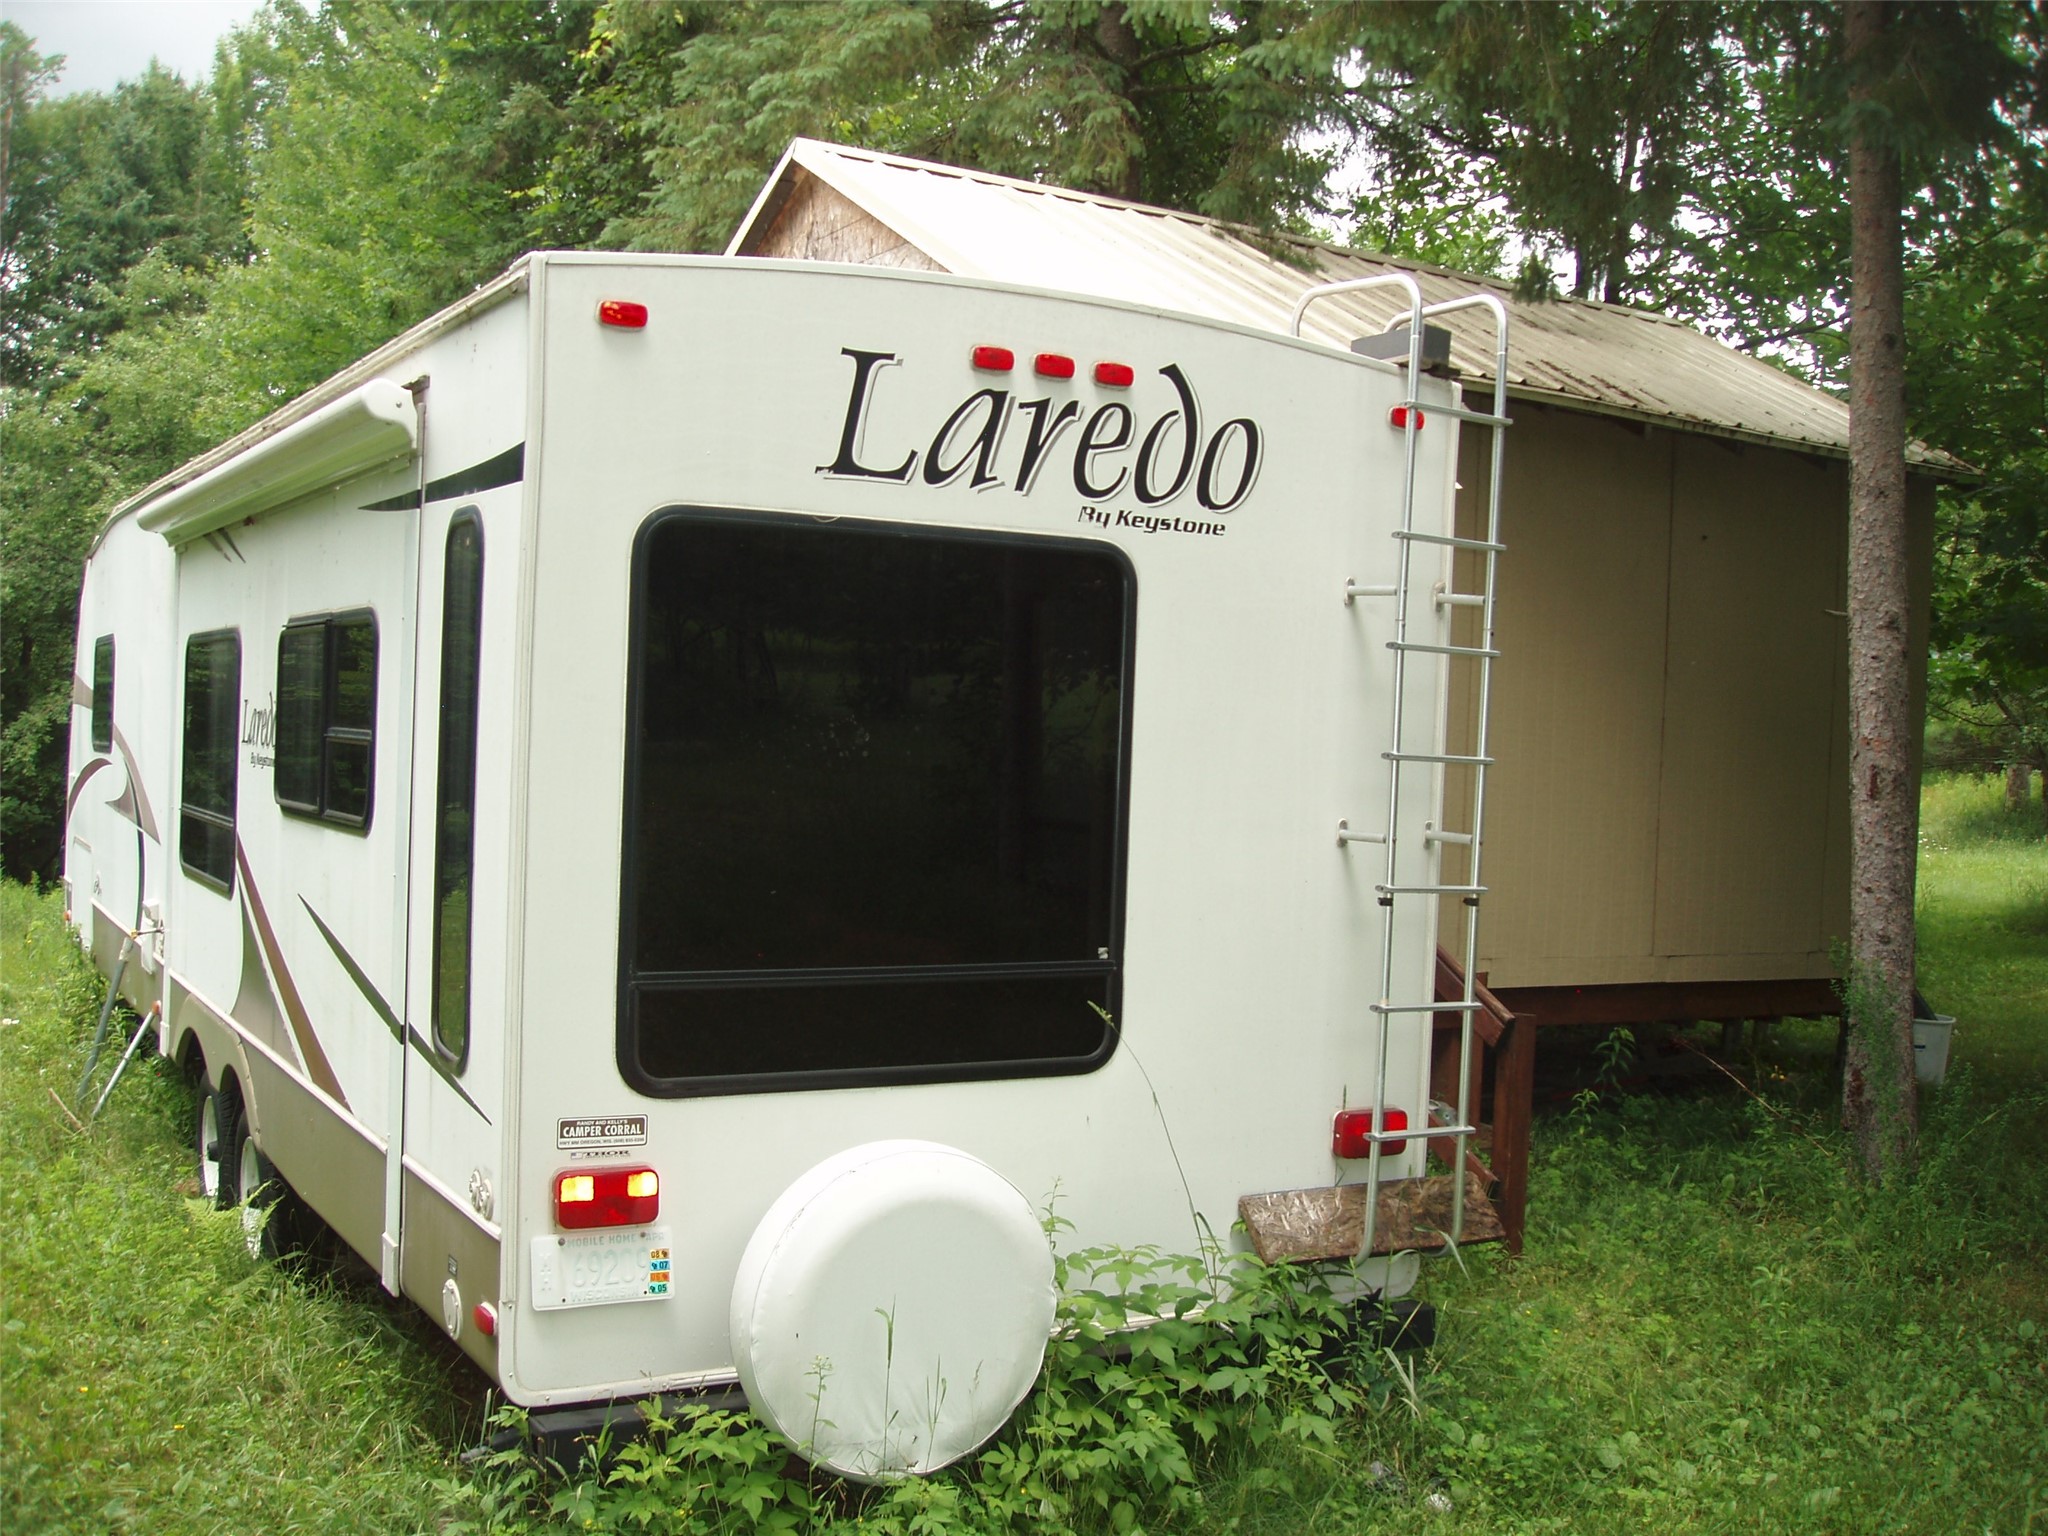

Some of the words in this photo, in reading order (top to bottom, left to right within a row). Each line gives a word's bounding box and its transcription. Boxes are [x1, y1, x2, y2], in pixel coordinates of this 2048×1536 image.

[815, 347, 1264, 513] Laredo
[1115, 509, 1226, 536] Keystone
[241, 691, 276, 750] Lared
[563, 1125, 602, 1138] CAMPER
[604, 1123, 642, 1136] CORRAL
[567, 1235, 605, 1248] MOBILE
[608, 1233, 636, 1245] HOME
[651, 1250, 660, 1259] 08
[659, 1260, 669, 1270] 07
[657, 1283, 667, 1293] 05
